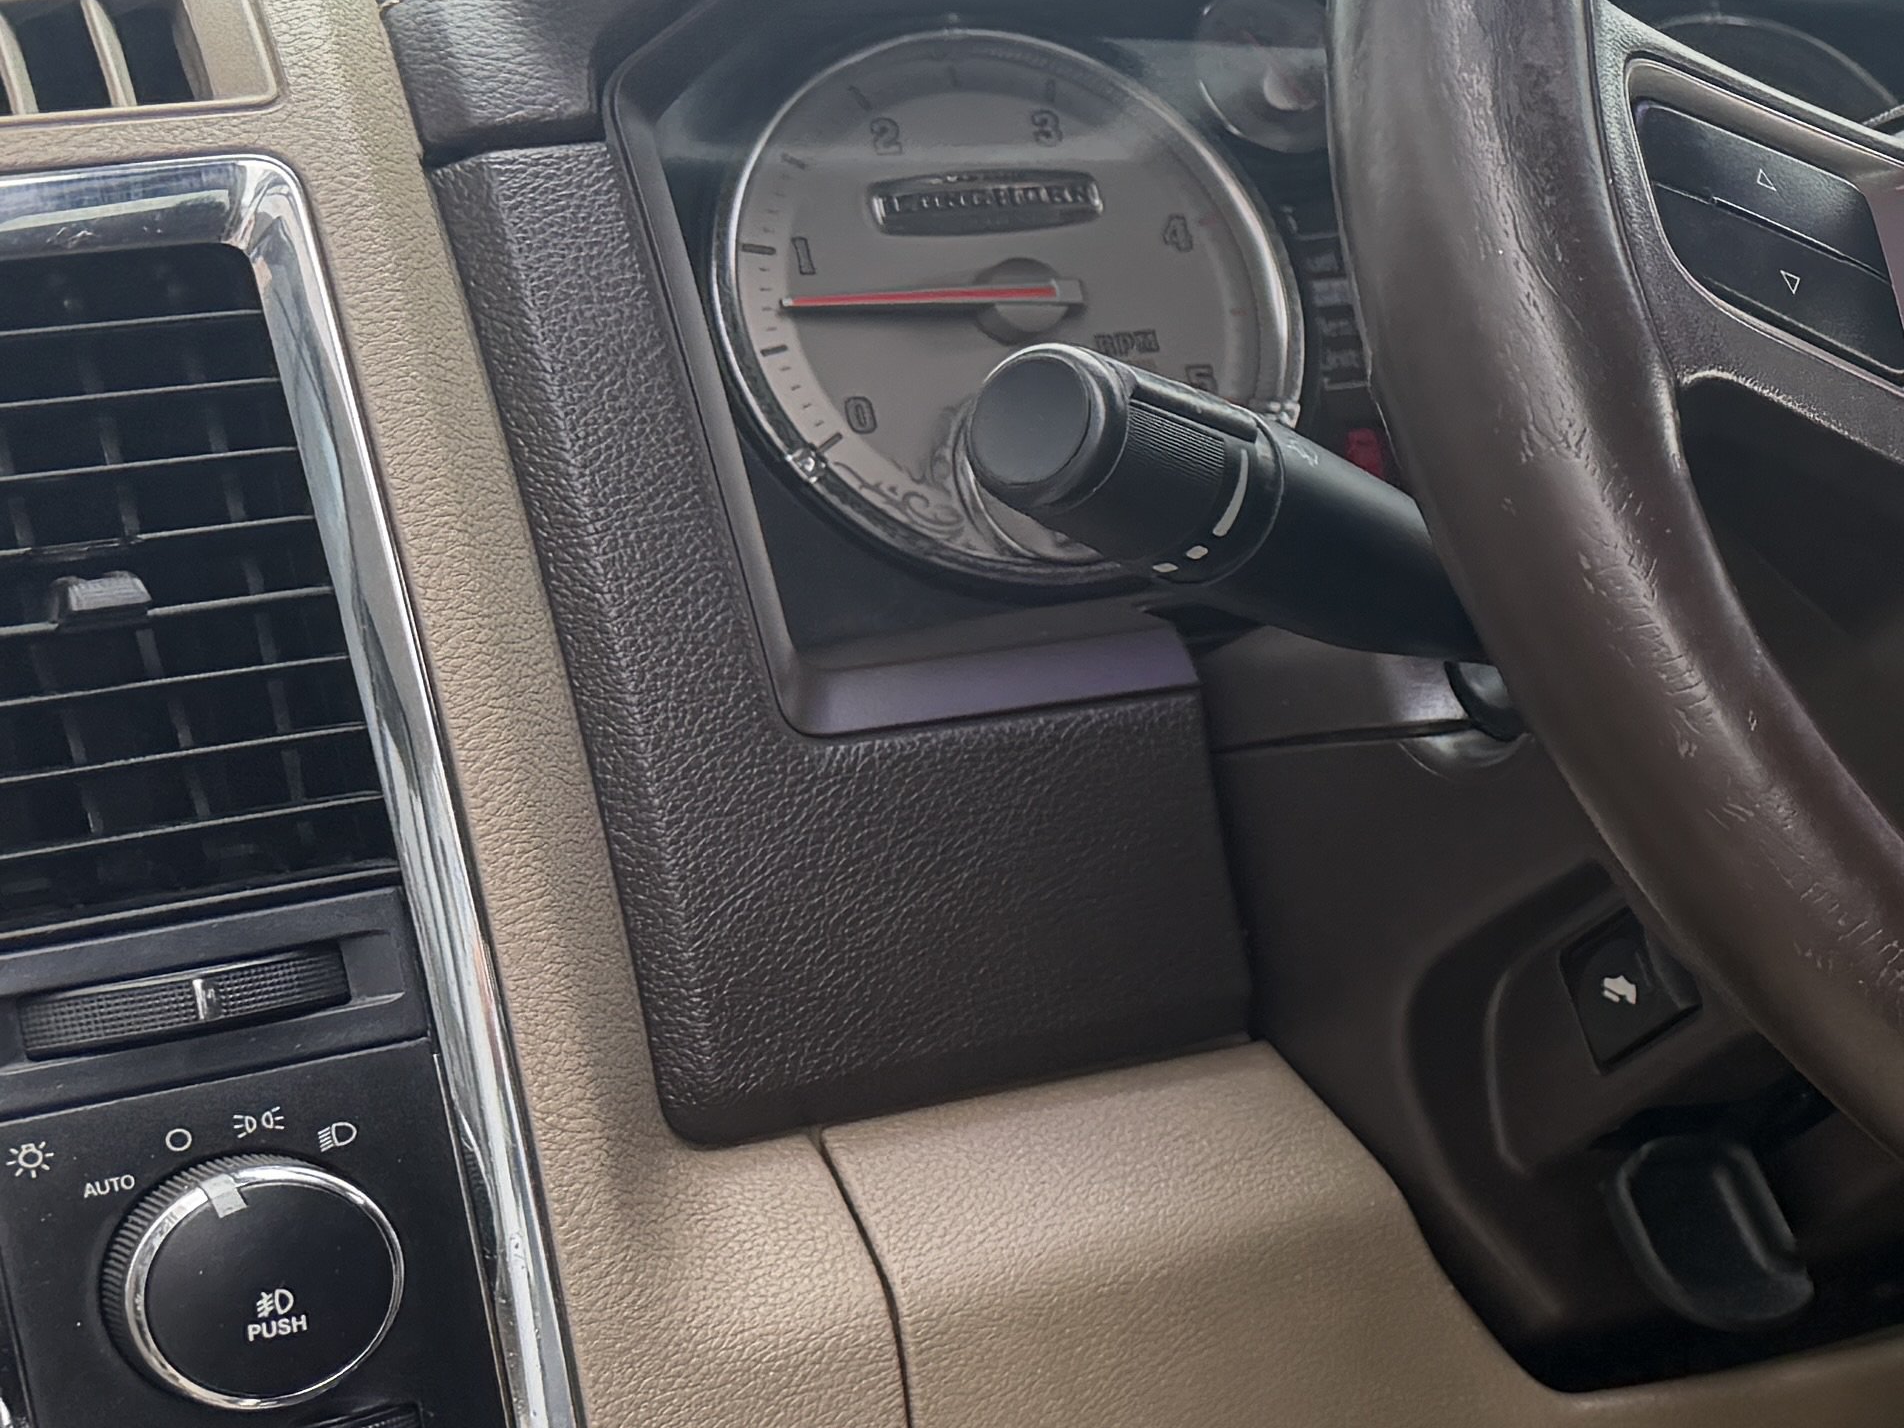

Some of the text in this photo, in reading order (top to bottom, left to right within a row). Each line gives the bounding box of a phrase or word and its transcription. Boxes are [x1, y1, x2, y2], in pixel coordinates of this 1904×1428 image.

[870, 116, 902, 155] 2
[1030, 108, 1063, 147] 3
[1162, 214, 1194, 253] 4
[791, 235, 816, 276] 1
[844, 395, 878, 435] 0
[83, 1174, 136, 1199] AUTO
[247, 1314, 308, 1343] PUSH
